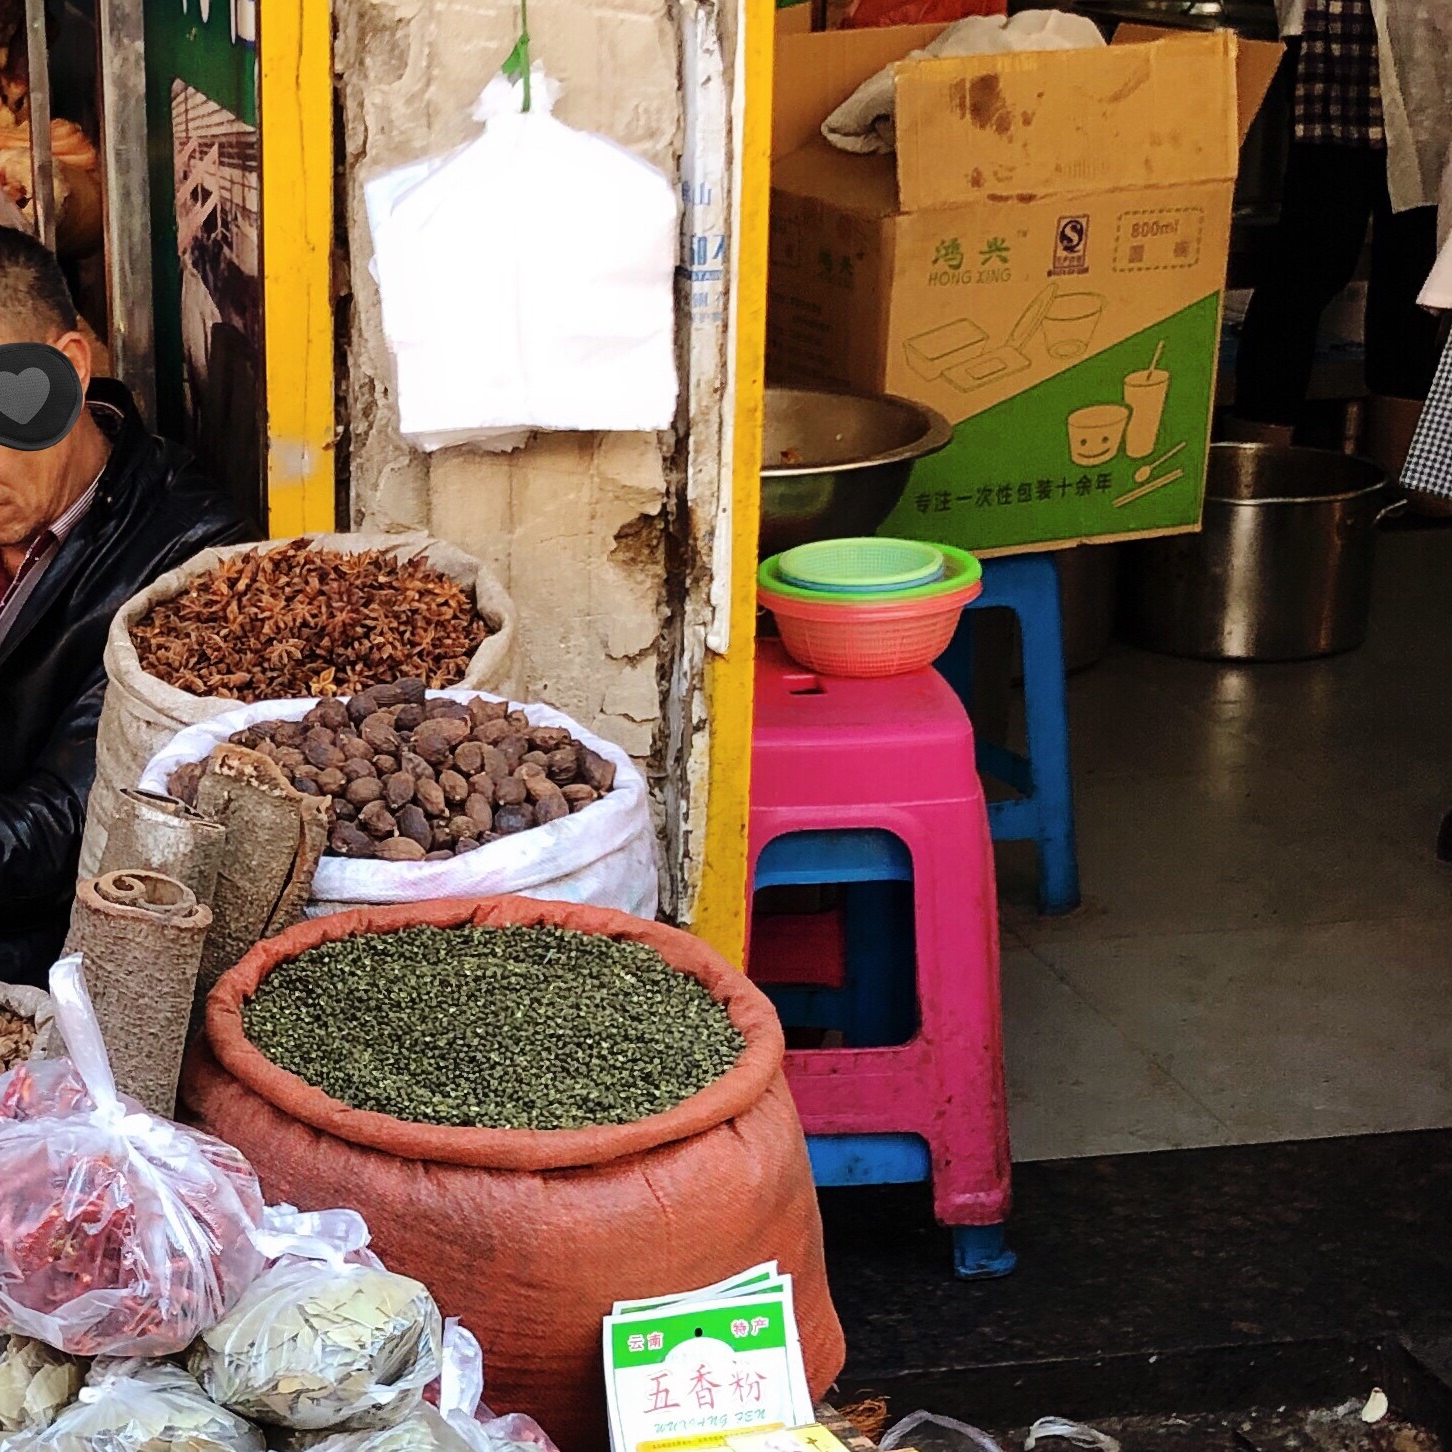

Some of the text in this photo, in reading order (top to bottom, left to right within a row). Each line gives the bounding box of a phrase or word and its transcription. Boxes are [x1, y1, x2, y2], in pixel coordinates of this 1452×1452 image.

[1130, 219, 1180, 239] 800ml
[932, 236, 1011, 270] 鸿兴
[928, 267, 1011, 286] HONG XING
[915, 472, 1113, 516] 专注一次性包装十余年
[628, 1316, 769, 1352] 云南 特产
[643, 1363, 768, 1414] 五香粉
